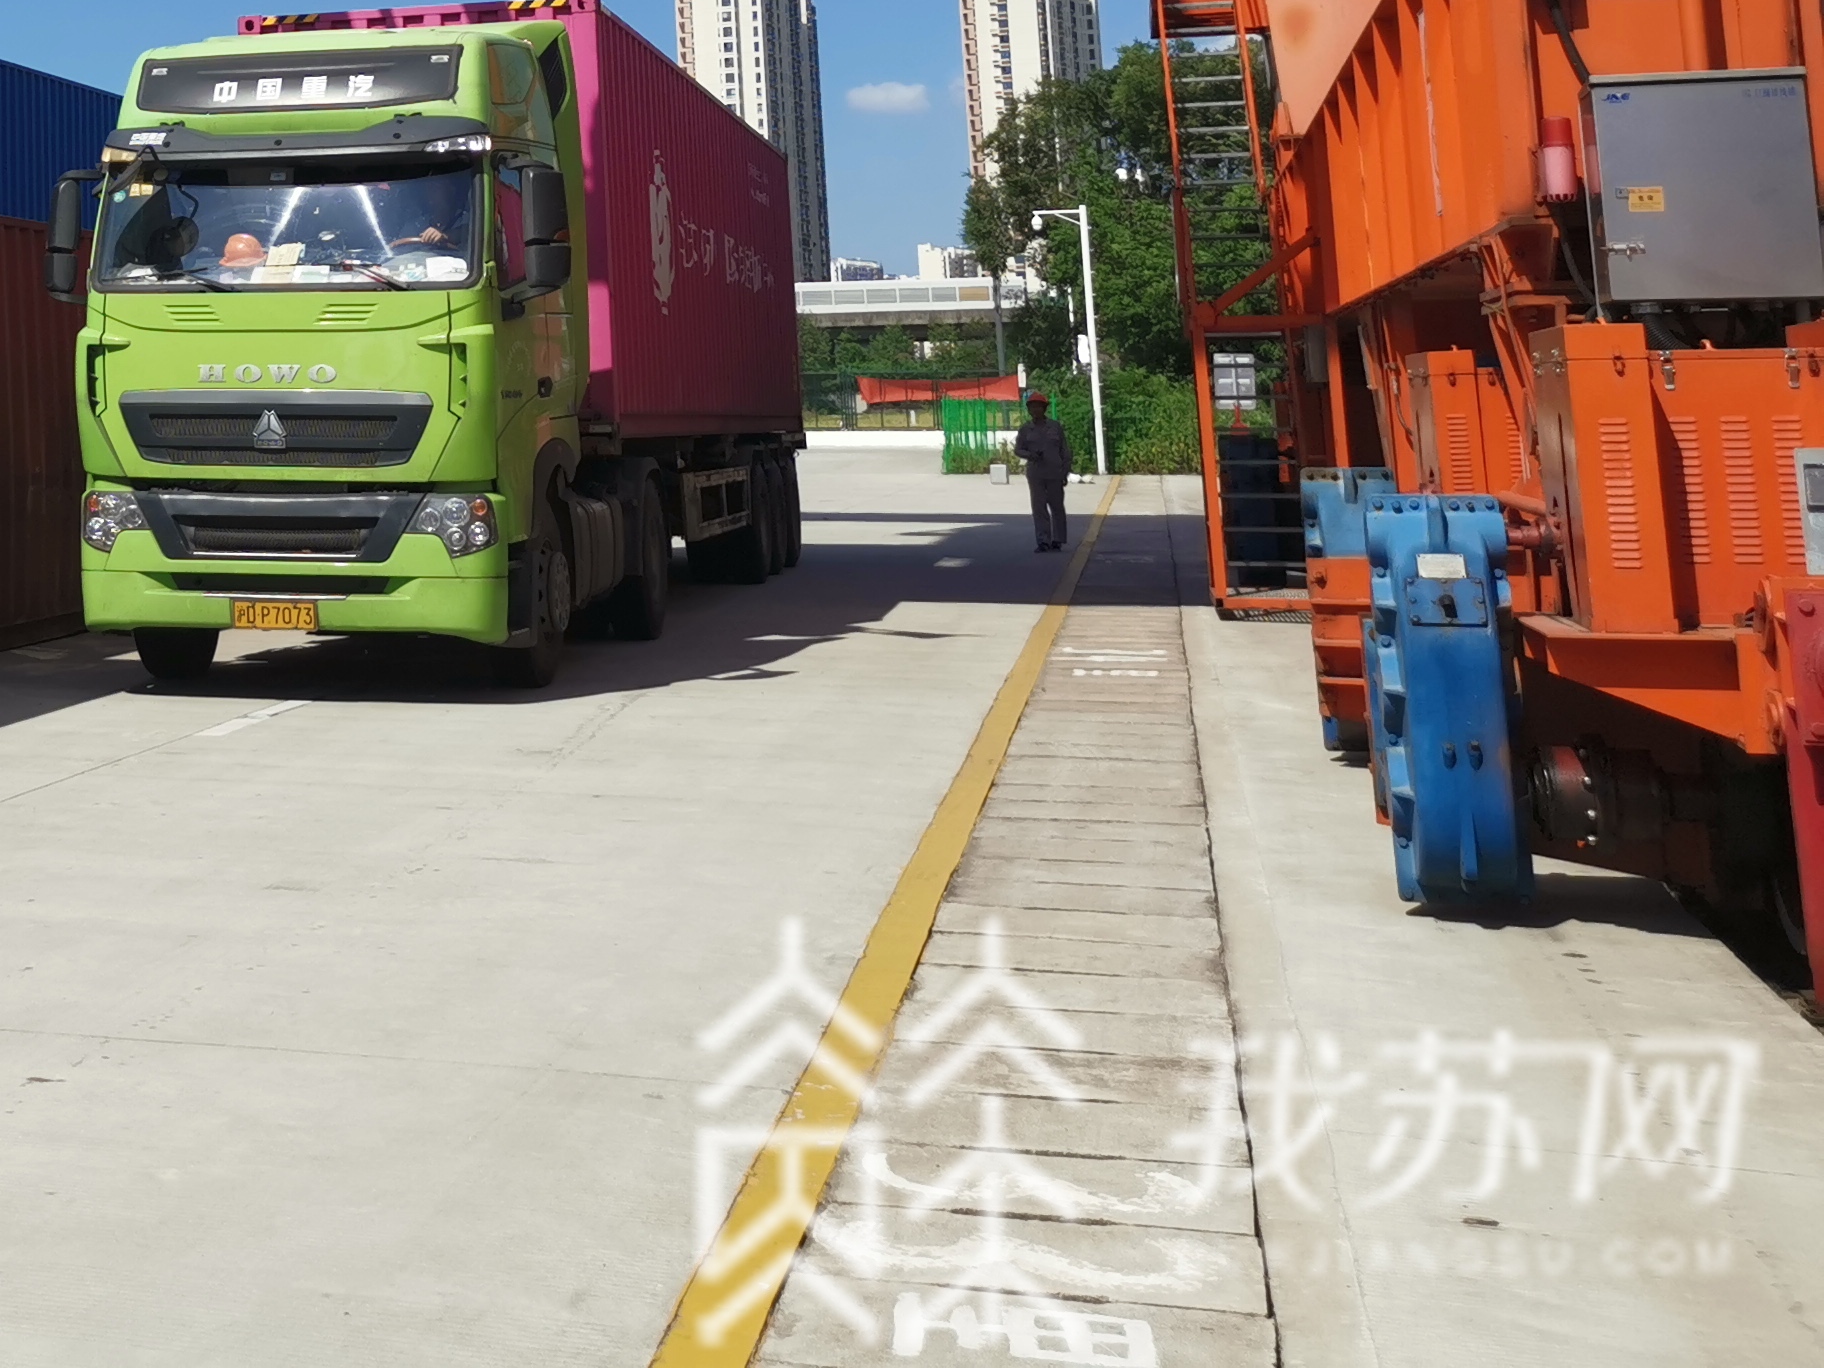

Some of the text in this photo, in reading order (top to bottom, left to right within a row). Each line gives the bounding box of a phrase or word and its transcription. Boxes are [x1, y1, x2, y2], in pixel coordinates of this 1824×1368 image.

[213, 74, 375, 103] 中国重汽
[197, 363, 337, 384] HOWO
